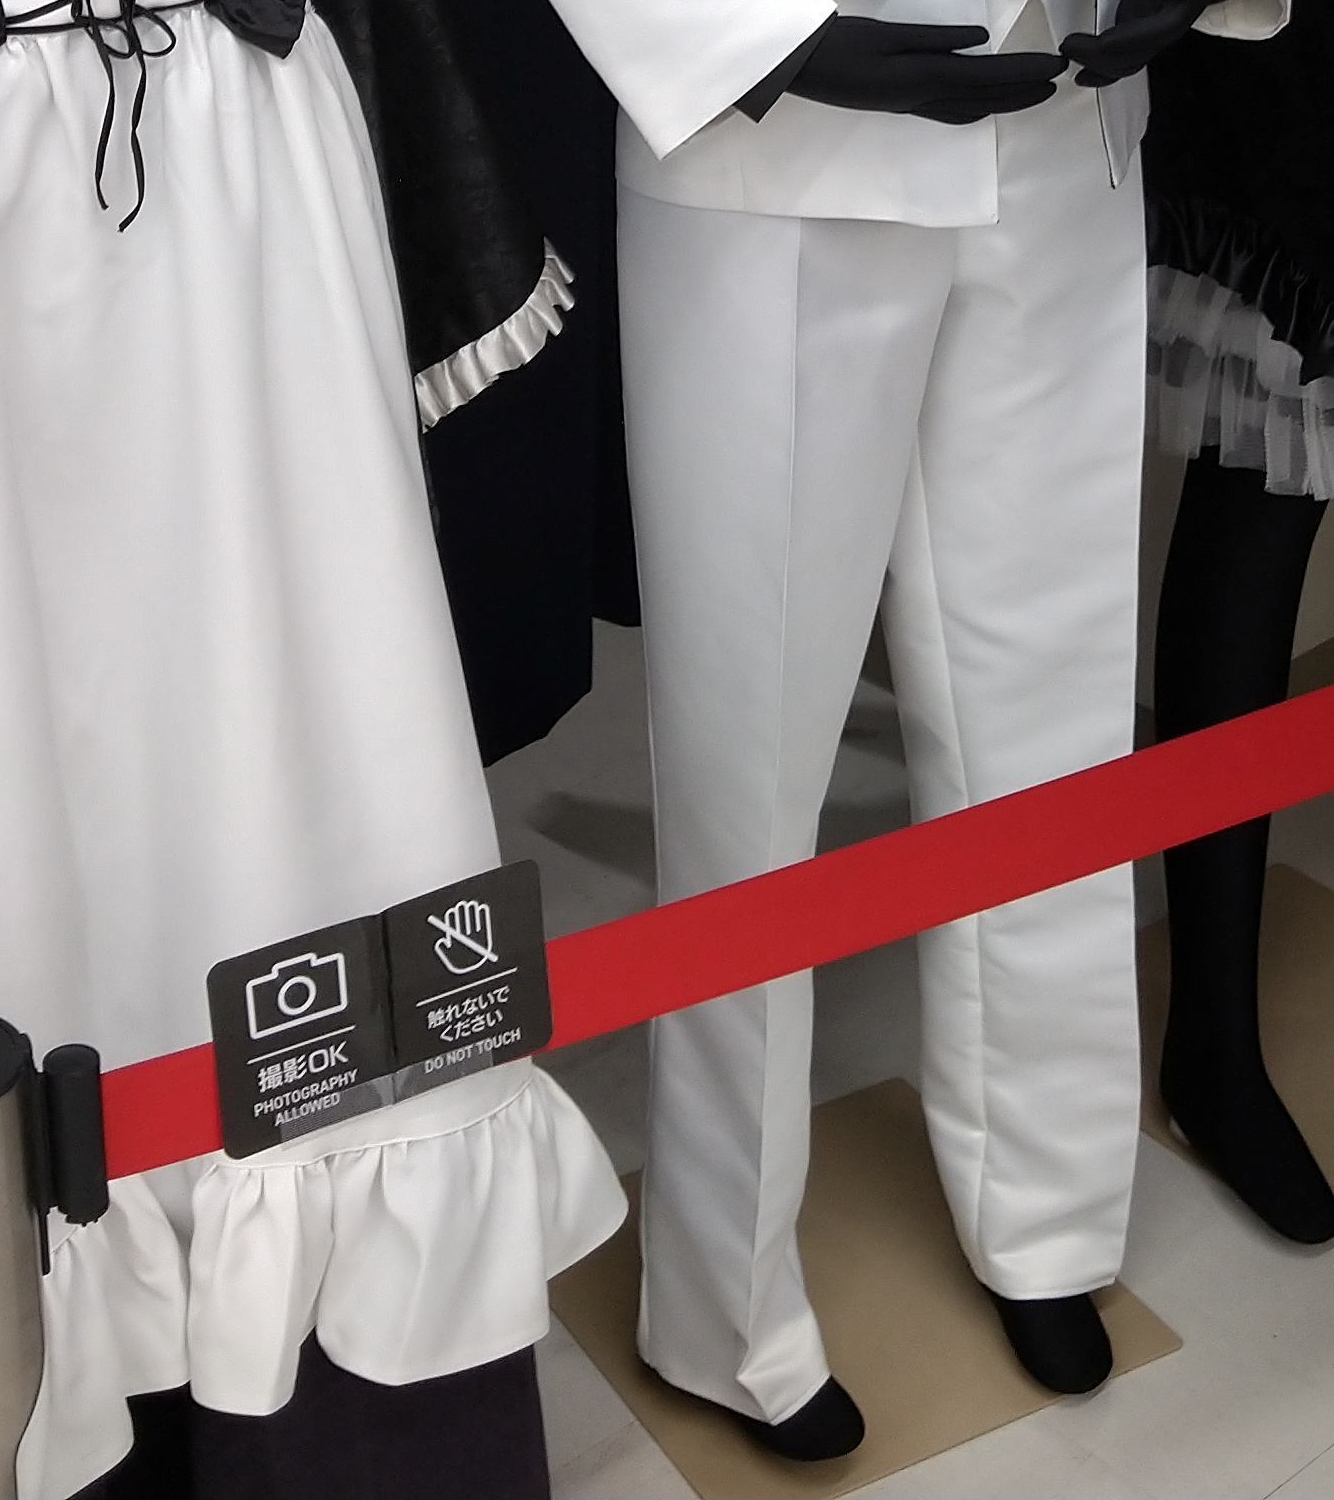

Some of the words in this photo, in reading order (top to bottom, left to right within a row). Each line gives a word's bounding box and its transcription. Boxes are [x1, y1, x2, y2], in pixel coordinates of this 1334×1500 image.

[427, 985, 510, 1030] 触れないで
[440, 1009, 504, 1042] ください
[258, 1041, 349, 1093] 撮影OK
[425, 1056, 444, 1074] DO
[446, 1043, 474, 1067] NOT
[475, 1027, 521, 1055] TOUCH
[253, 1068, 358, 1118] PHOTOGRAPHY
[274, 1092, 341, 1127] ALLOWED
